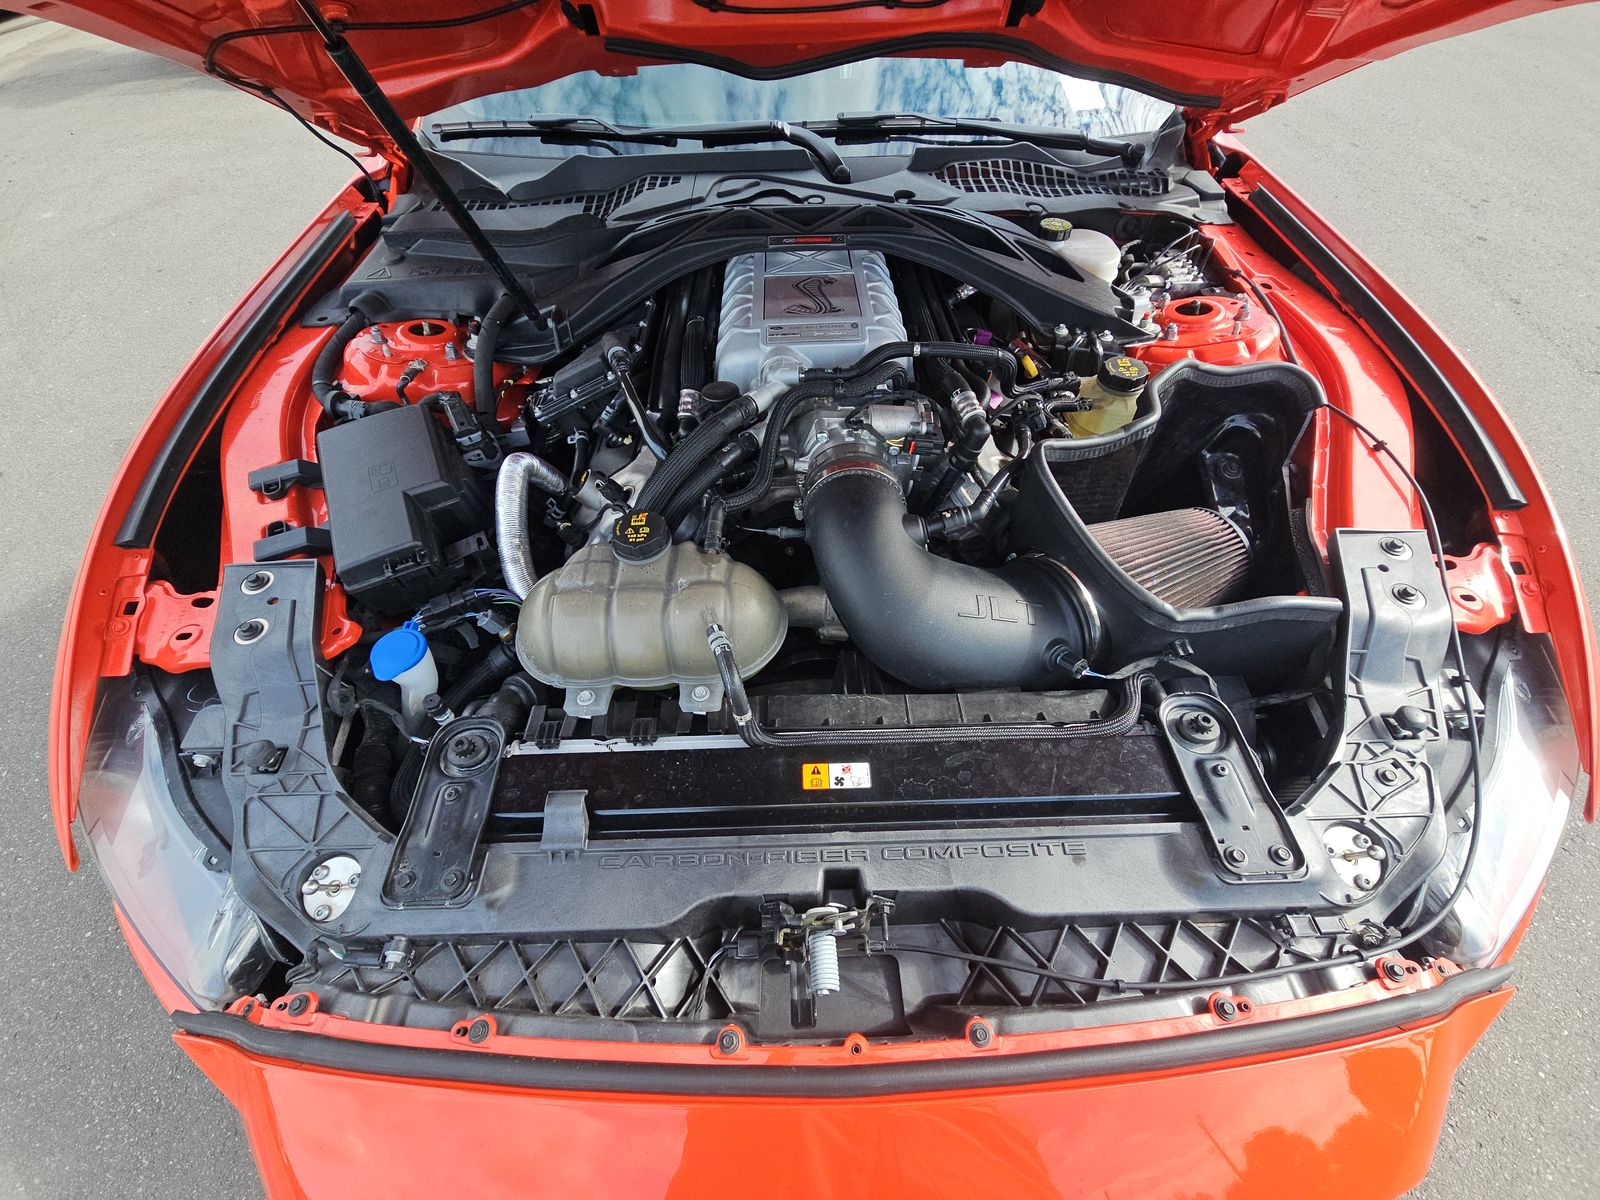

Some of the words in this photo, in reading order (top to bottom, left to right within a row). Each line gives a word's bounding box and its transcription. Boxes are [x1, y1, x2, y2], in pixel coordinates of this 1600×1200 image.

[957, 594, 1042, 626] JLT
[601, 847, 870, 870] CARBON-FIBER
[881, 841, 1087, 861] COMPOSITE
